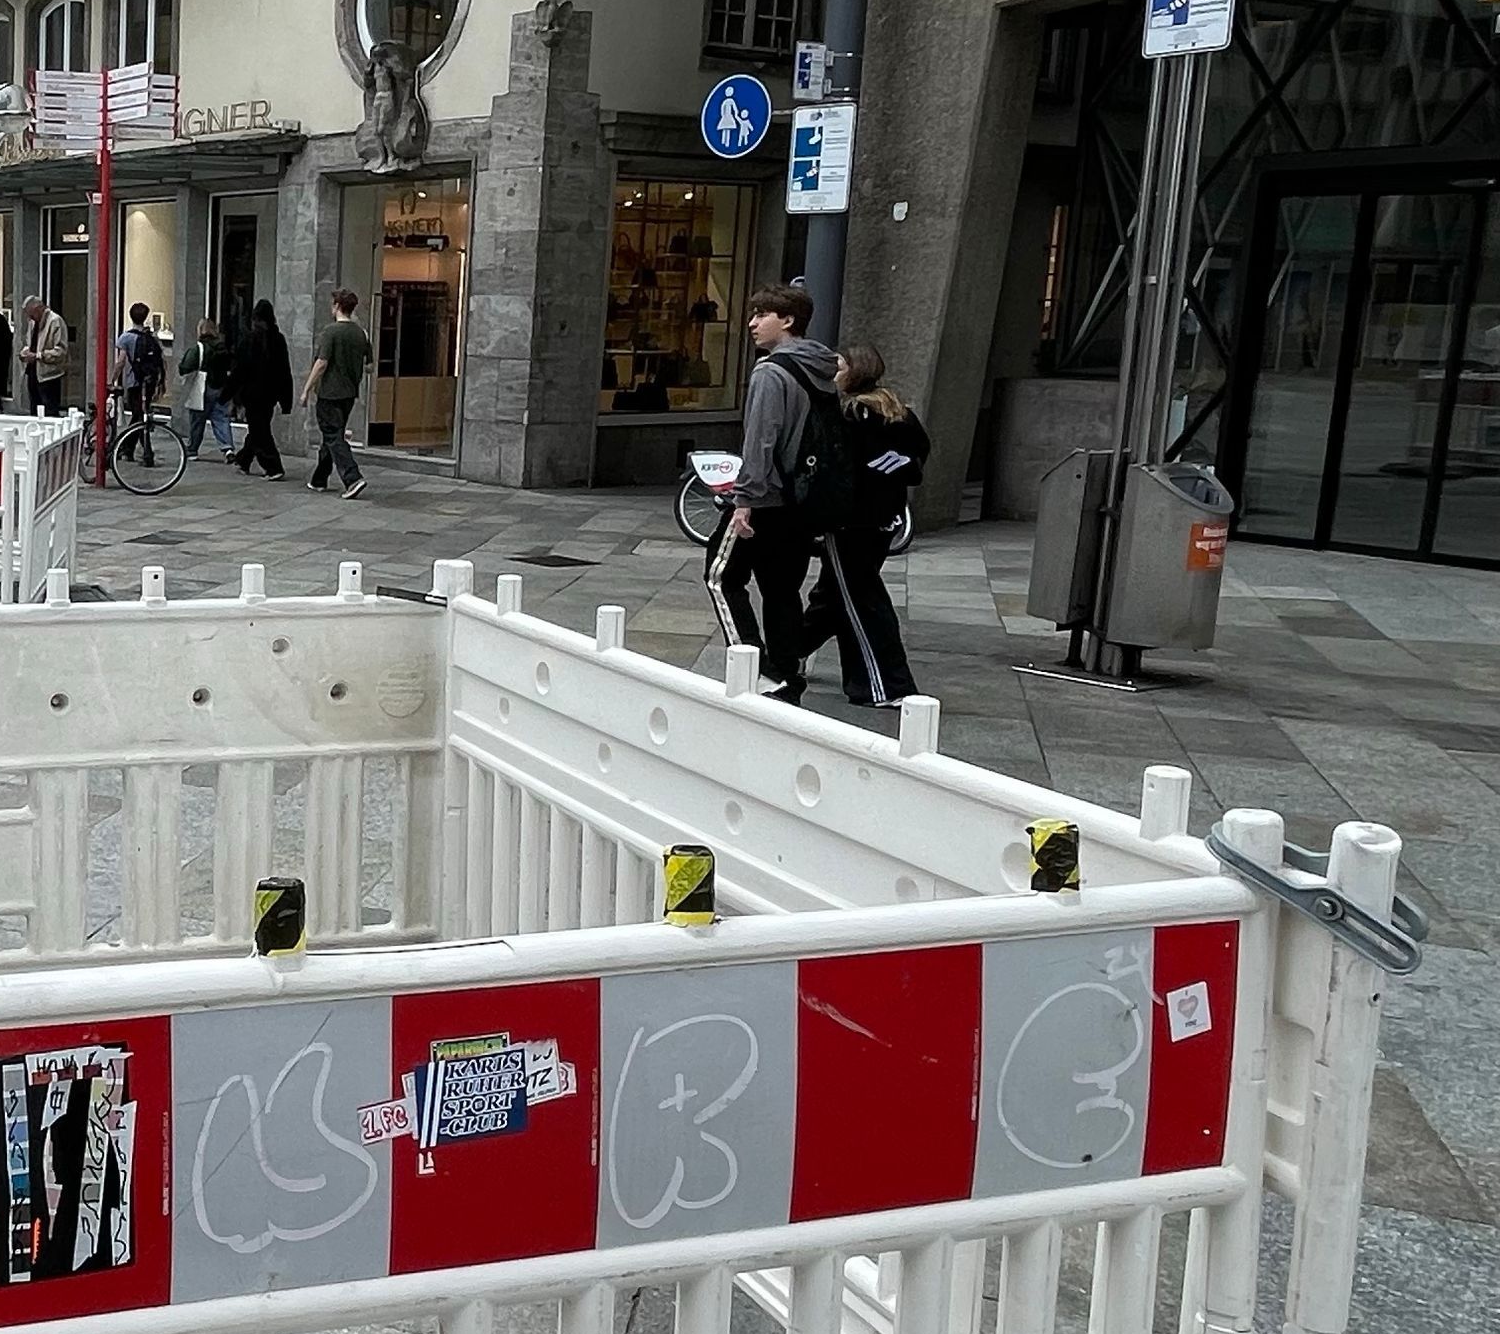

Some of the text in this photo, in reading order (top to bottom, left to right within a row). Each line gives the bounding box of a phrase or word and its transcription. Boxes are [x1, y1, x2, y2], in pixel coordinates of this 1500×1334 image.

[179, 99, 273, 138] IGNER
[445, 1051, 522, 1081] KARLS
[441, 1090, 517, 1120] SPORT
